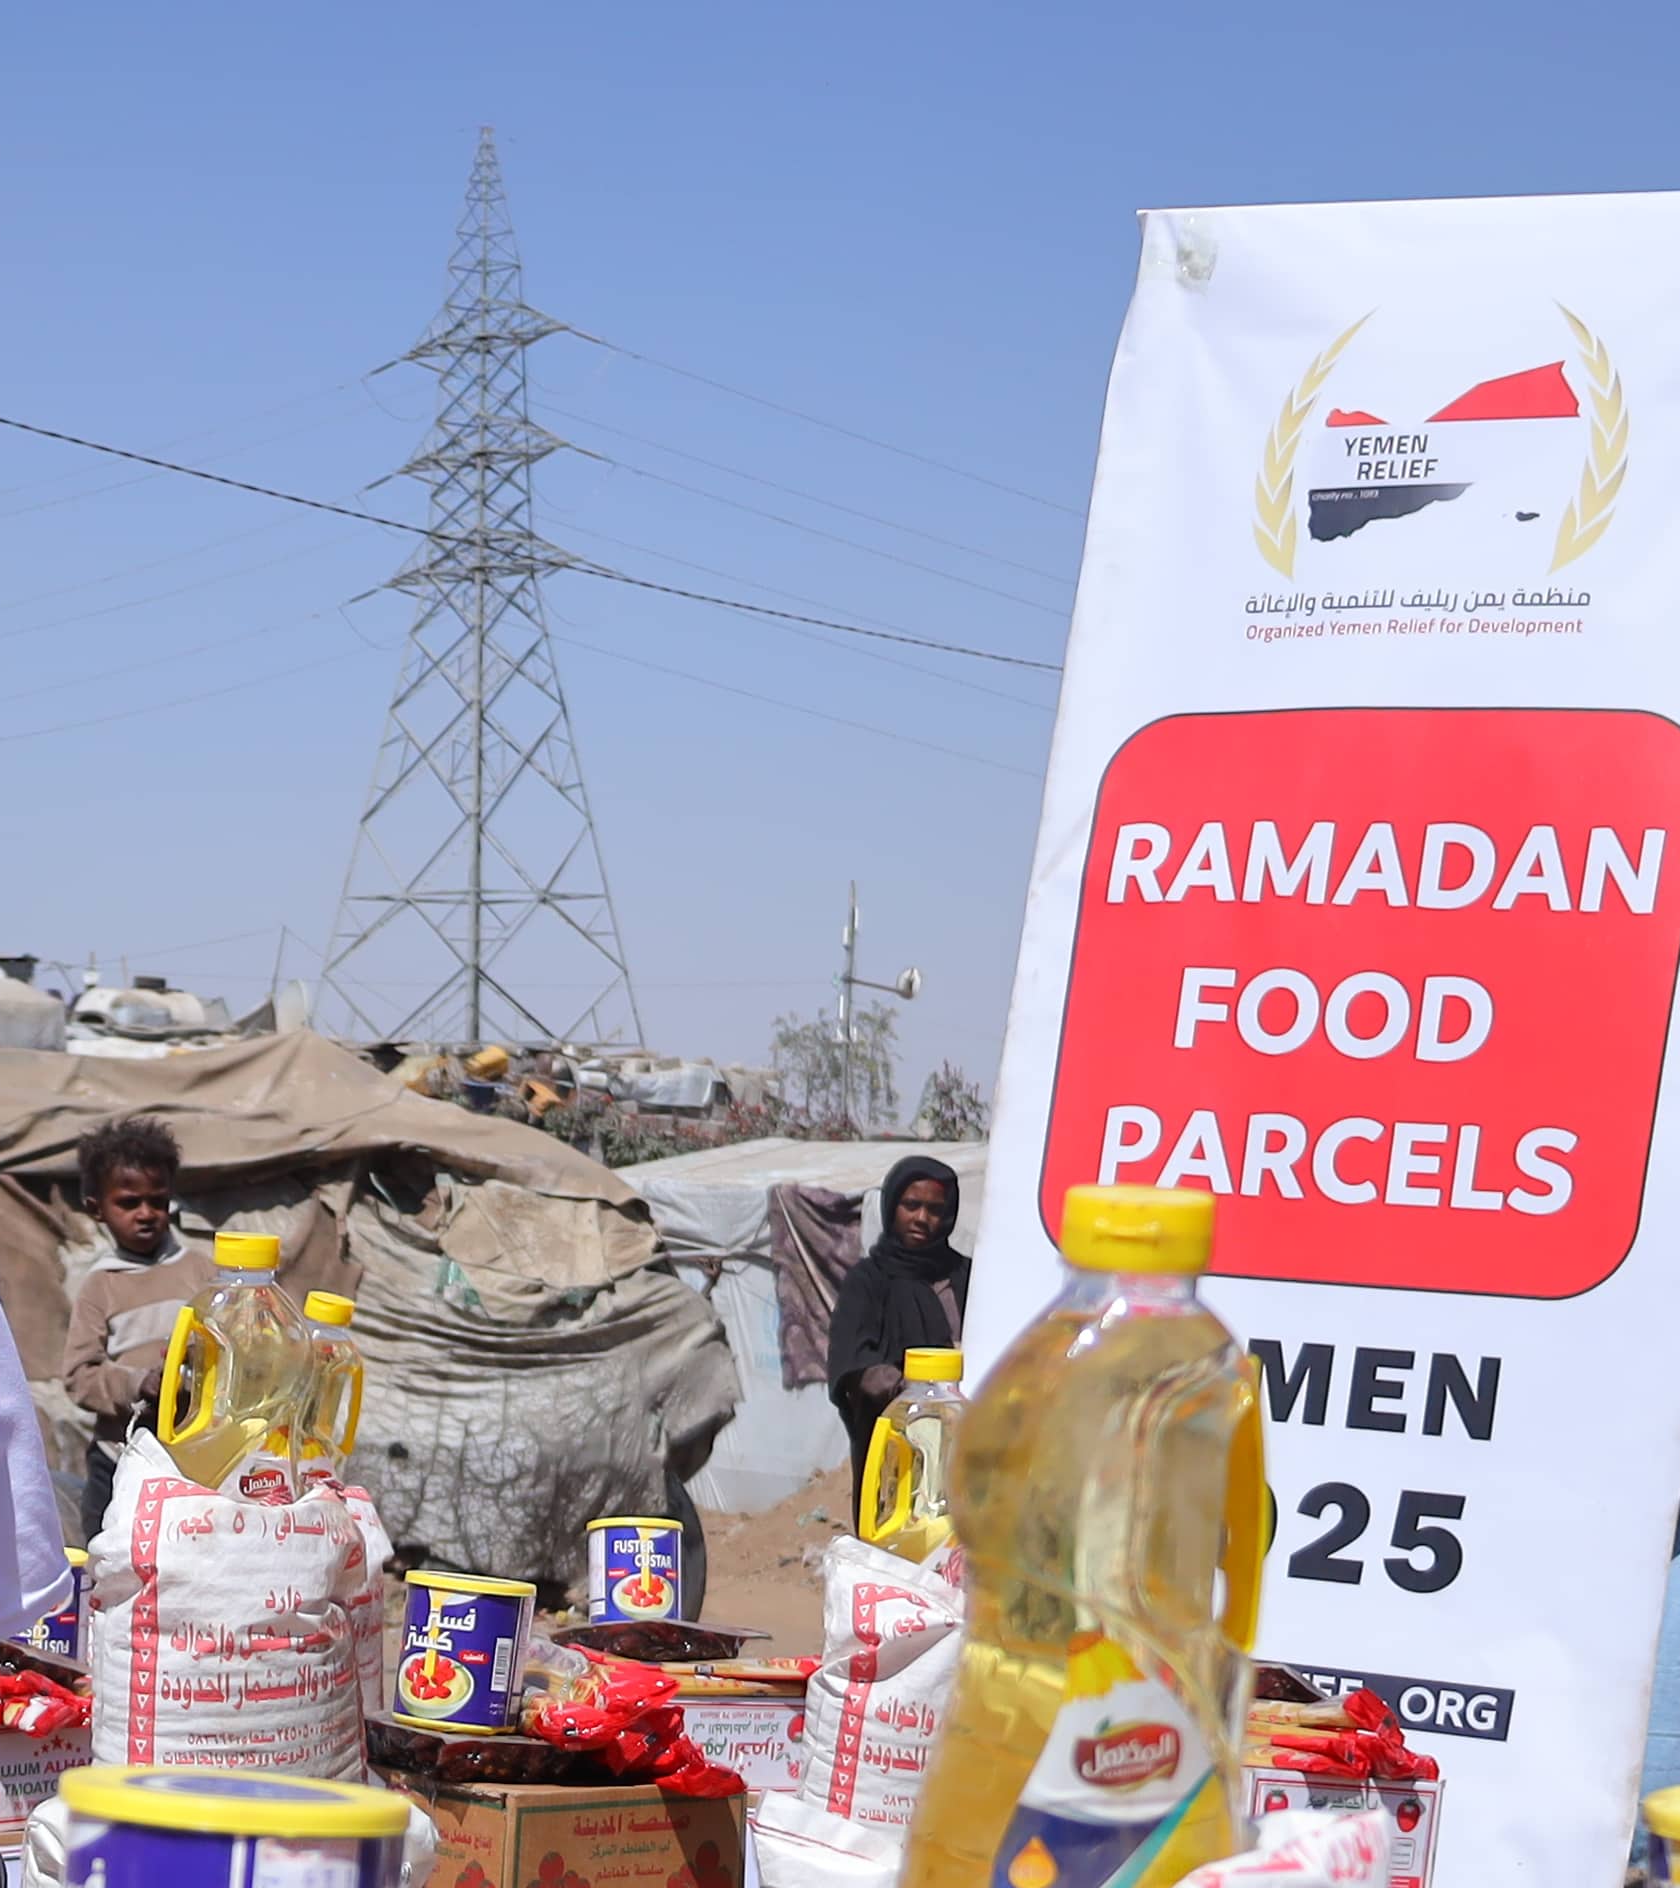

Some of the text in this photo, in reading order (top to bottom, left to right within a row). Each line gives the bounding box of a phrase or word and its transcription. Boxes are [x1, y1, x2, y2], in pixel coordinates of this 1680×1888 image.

[1344, 434, 1428, 456] YEMEN
[1357, 458, 1438, 481] RELIEF
[1245, 588, 1591, 619] منظمة يمن ريليف للتنمية والإغاثة
[1245, 618, 1584, 642] Organized Yemen Relief for Development
[1106, 820, 1667, 915] RAMADAN
[1174, 966, 1494, 1063] FOOD
[1095, 1105, 1578, 1215] PARCELS
[1248, 1338, 1502, 1442] MEN
[614, 1540, 655, 1553] FUSTER
[1267, 1482, 1467, 1594] 25
[634, 1553, 673, 1568] CUSTAR
[264, 1586, 303, 1615] وارد
[169, 1623, 234, 1662] وإخوانه
[404, 1625, 453, 1651] كستر
[161, 1672, 230, 1710] المحدودة
[1399, 1686, 1498, 1731] ORG
[874, 1695, 936, 1737] وإخوانه
